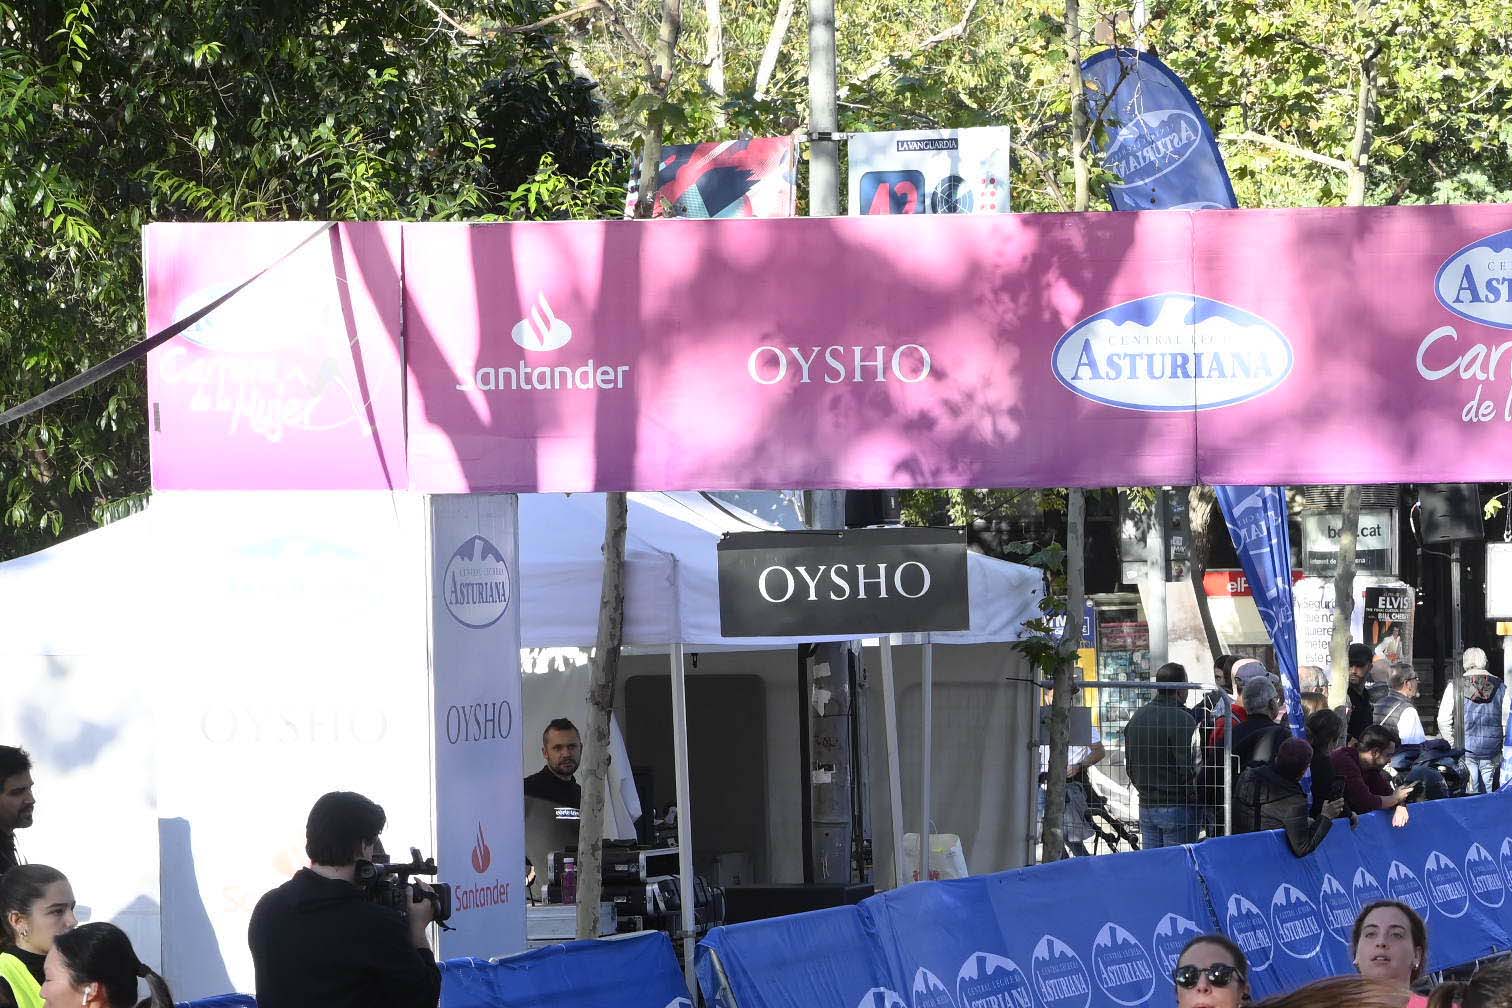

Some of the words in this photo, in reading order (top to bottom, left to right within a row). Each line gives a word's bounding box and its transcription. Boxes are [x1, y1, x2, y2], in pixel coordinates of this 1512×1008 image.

[456, 360, 629, 391] Santander
[748, 343, 932, 384] OYSHO
[1071, 337, 1273, 381] ASTURIANA
[1462, 387, 1496, 422] de
[448, 569, 507, 605] ASTURIANA
[759, 560, 931, 603] OYSHO
[446, 700, 512, 745] OYSHO
[455, 880, 510, 912] Santander
[1038, 970, 1089, 1003] ASTURIANA
[1098, 957, 1153, 989] ASTURIANA
